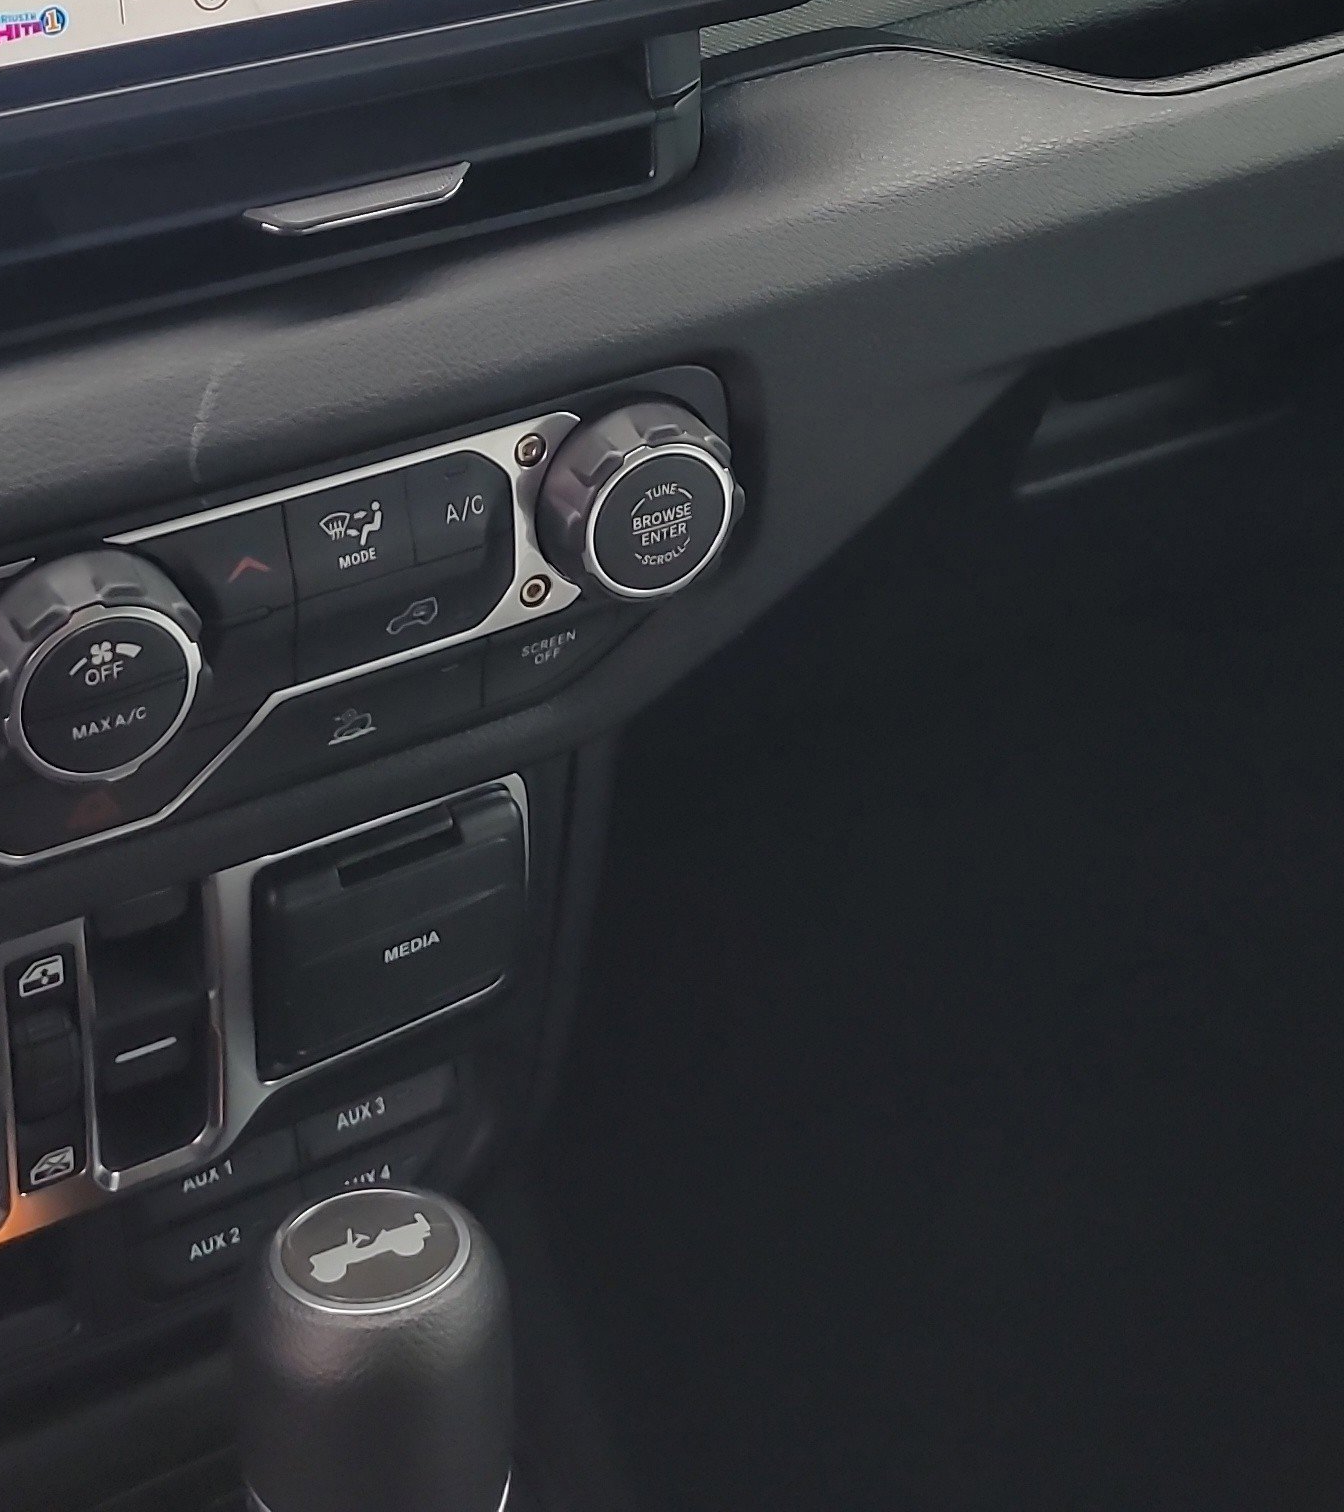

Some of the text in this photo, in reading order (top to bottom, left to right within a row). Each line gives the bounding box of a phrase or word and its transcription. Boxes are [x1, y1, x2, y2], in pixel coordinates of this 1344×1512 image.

[645, 483, 677, 501] TUNE
[446, 494, 484, 525] A/C
[632, 502, 692, 530] BROWSE
[642, 522, 687, 546] ENTER
[338, 547, 377, 570] MODE
[641, 545, 686, 565] SCROLL
[522, 630, 576, 657] SCREEN
[534, 647, 560, 665] OFF
[85, 660, 124, 685] OFF
[72, 707, 146, 740] MAX A/C
[384, 931, 440, 964] MEDIA
[337, 1097, 386, 1131] AUX 3
[182, 1160, 234, 1193] AUX 1
[189, 1227, 241, 1261] AUX 2
